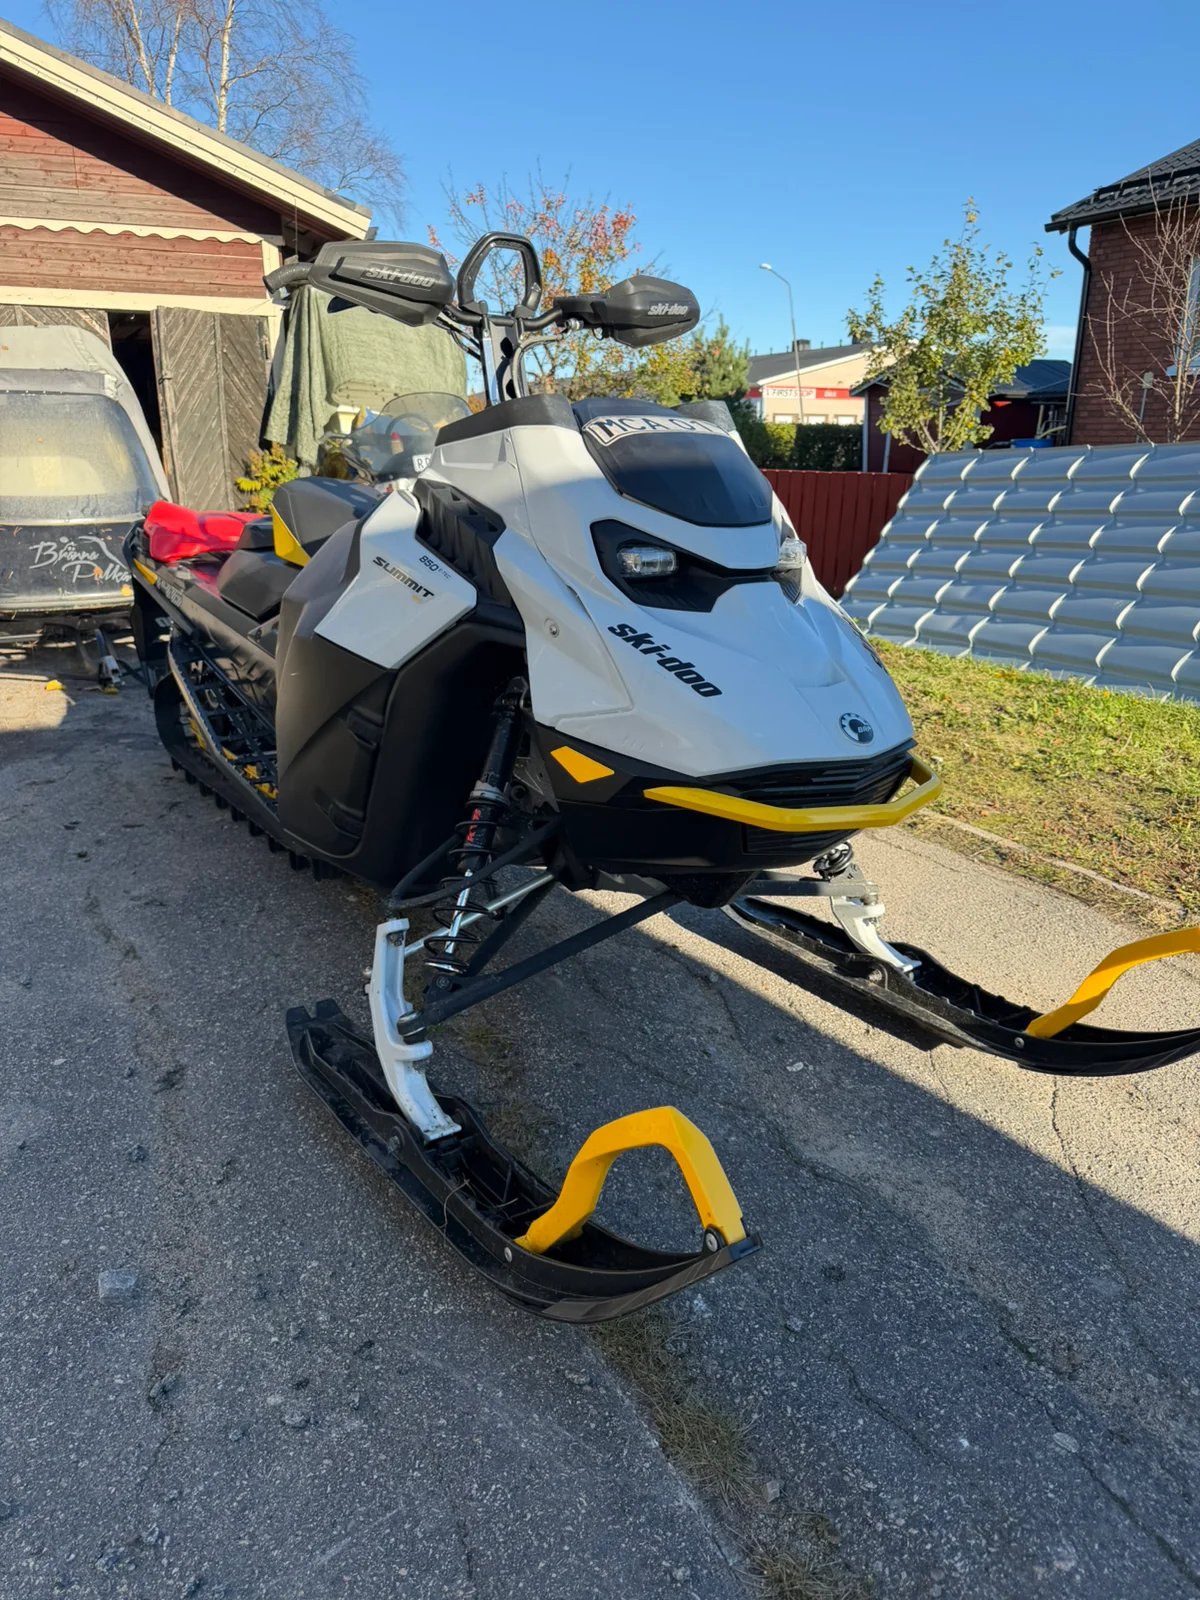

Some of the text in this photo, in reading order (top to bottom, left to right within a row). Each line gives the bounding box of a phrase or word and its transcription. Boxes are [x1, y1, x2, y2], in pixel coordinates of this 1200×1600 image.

[372, 556, 435, 598] SUMMIT
[419, 554, 439, 572] 850
[607, 623, 723, 698] ski-doo
